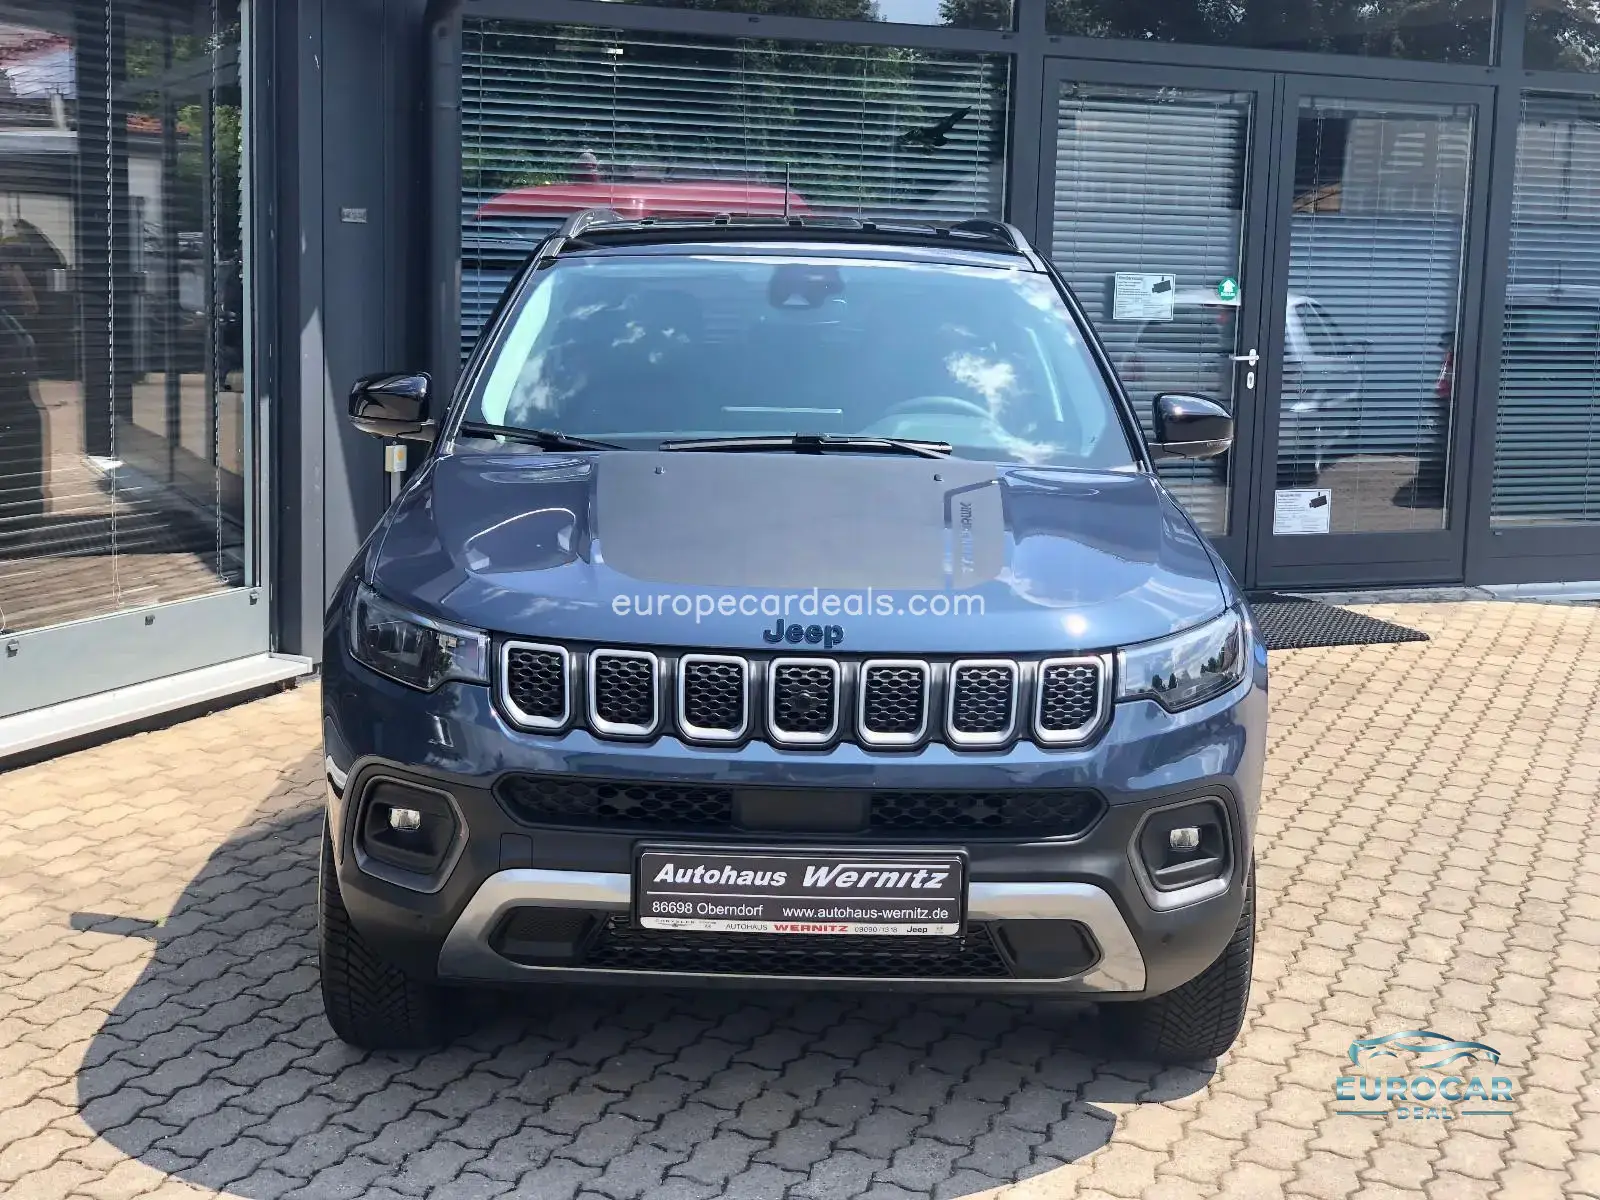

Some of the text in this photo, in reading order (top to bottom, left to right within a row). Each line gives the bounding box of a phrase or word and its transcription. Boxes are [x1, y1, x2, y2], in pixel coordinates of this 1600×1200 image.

[762, 618, 844, 648] Jeep
[653, 863, 950, 889] Autohaus Wernitz
[652, 901, 949, 919] 86698 Oberndorf www.autohaus-wernitz.de
[725, 923, 768, 931] AUTOHAUS
[774, 923, 849, 932] WERNITZ
[906, 925, 928, 933] Jeep
